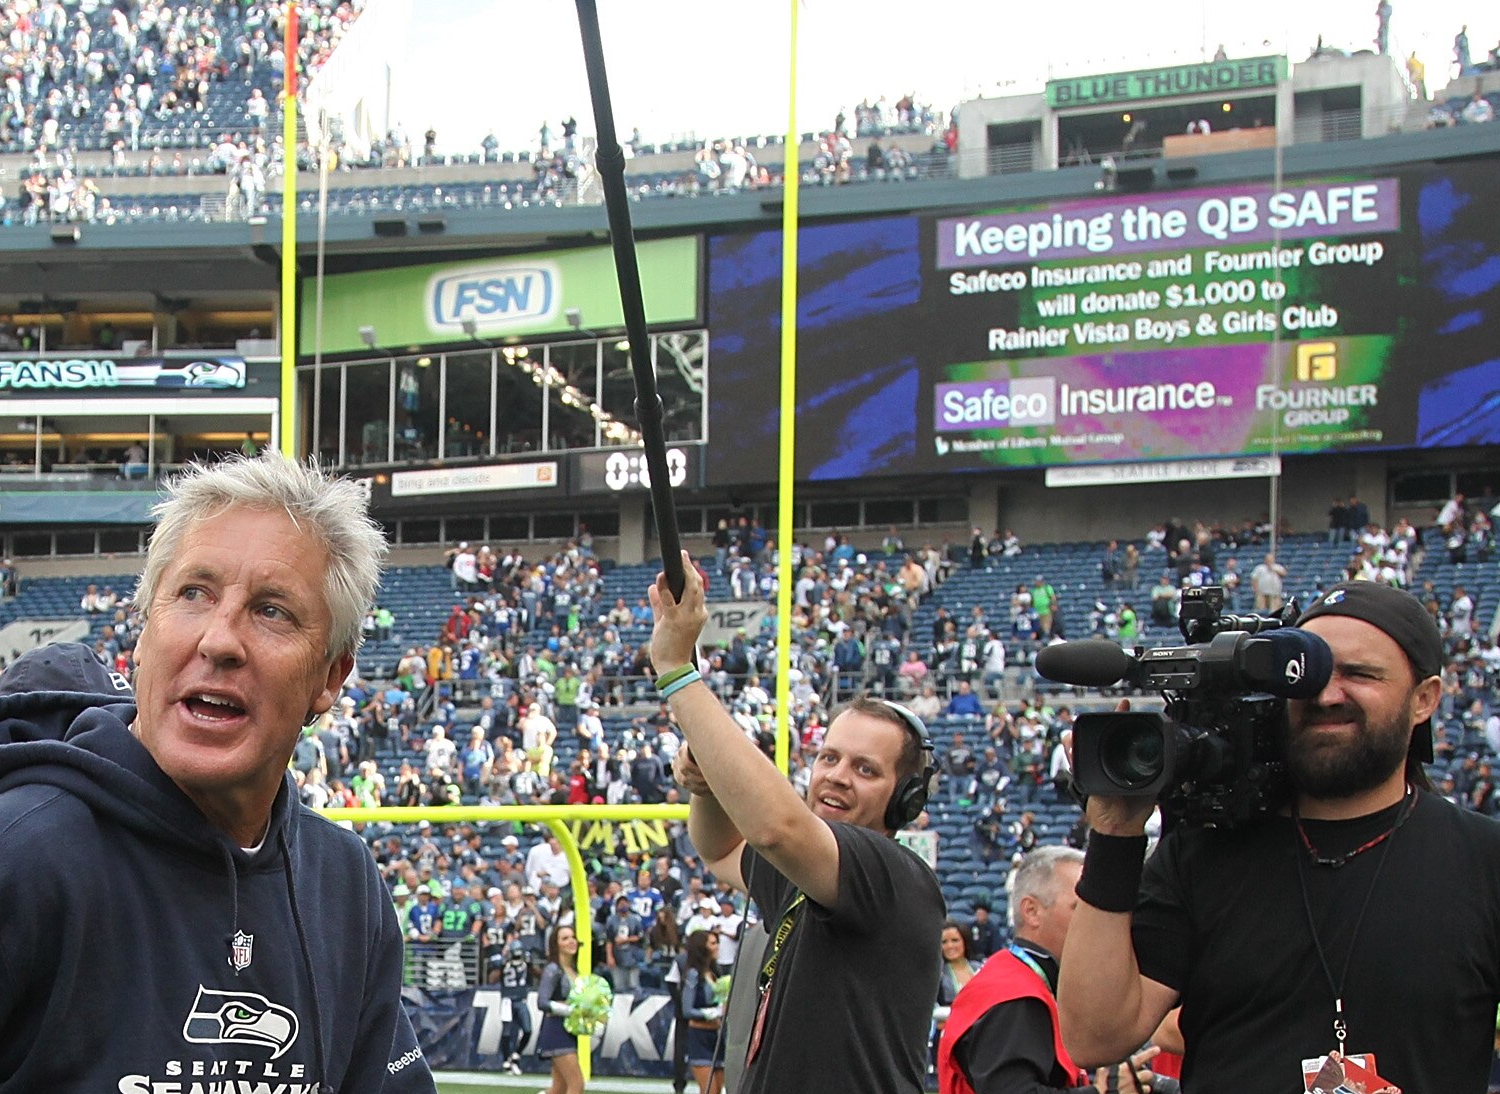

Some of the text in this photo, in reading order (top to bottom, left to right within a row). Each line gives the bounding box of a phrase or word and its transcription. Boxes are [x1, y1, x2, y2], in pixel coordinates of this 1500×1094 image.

[1056, 62, 1275, 101] BLUE THUNDER
[955, 184, 1378, 257] Keeping the QB SAFE
[950, 241, 1384, 295] Safeco Insurance and Fournier Group
[453, 275, 533, 318] FSN
[1036, 293, 1076, 318] will
[1080, 289, 1160, 315] donate
[1261, 279, 1286, 300] to
[988, 304, 1338, 351] Rainier Vista Boys & Girls Club
[943, 388, 1048, 424] Safeco
[1256, 384, 1378, 411] FOURNIER
[1283, 408, 1350, 428] GROUP
[620, 819, 669, 854] IN
[443, 911, 468, 931] 27
[166, 1060, 305, 1078] SEATTLE
